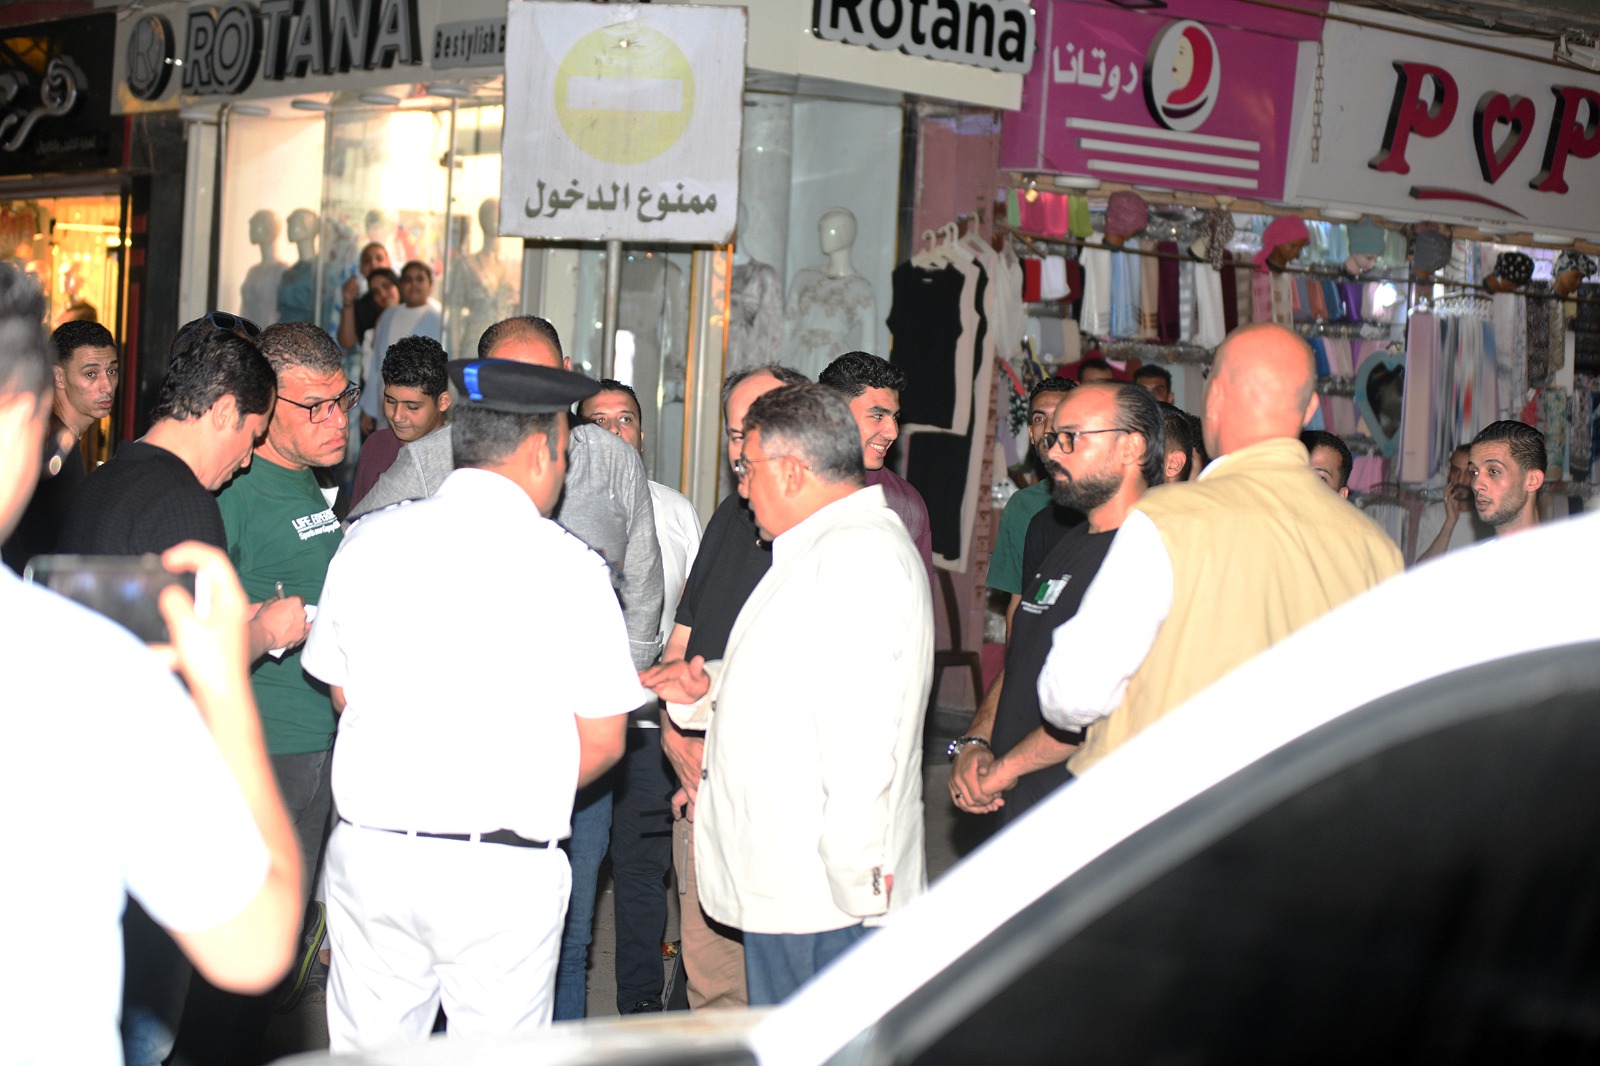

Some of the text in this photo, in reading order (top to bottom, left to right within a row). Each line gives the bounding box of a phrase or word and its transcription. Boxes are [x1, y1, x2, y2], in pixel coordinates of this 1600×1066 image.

[182, 0, 420, 94] ROTANA
[1053, 42, 1139, 101] روتانا
[525, 178, 717, 223] ممنوع الدخول
